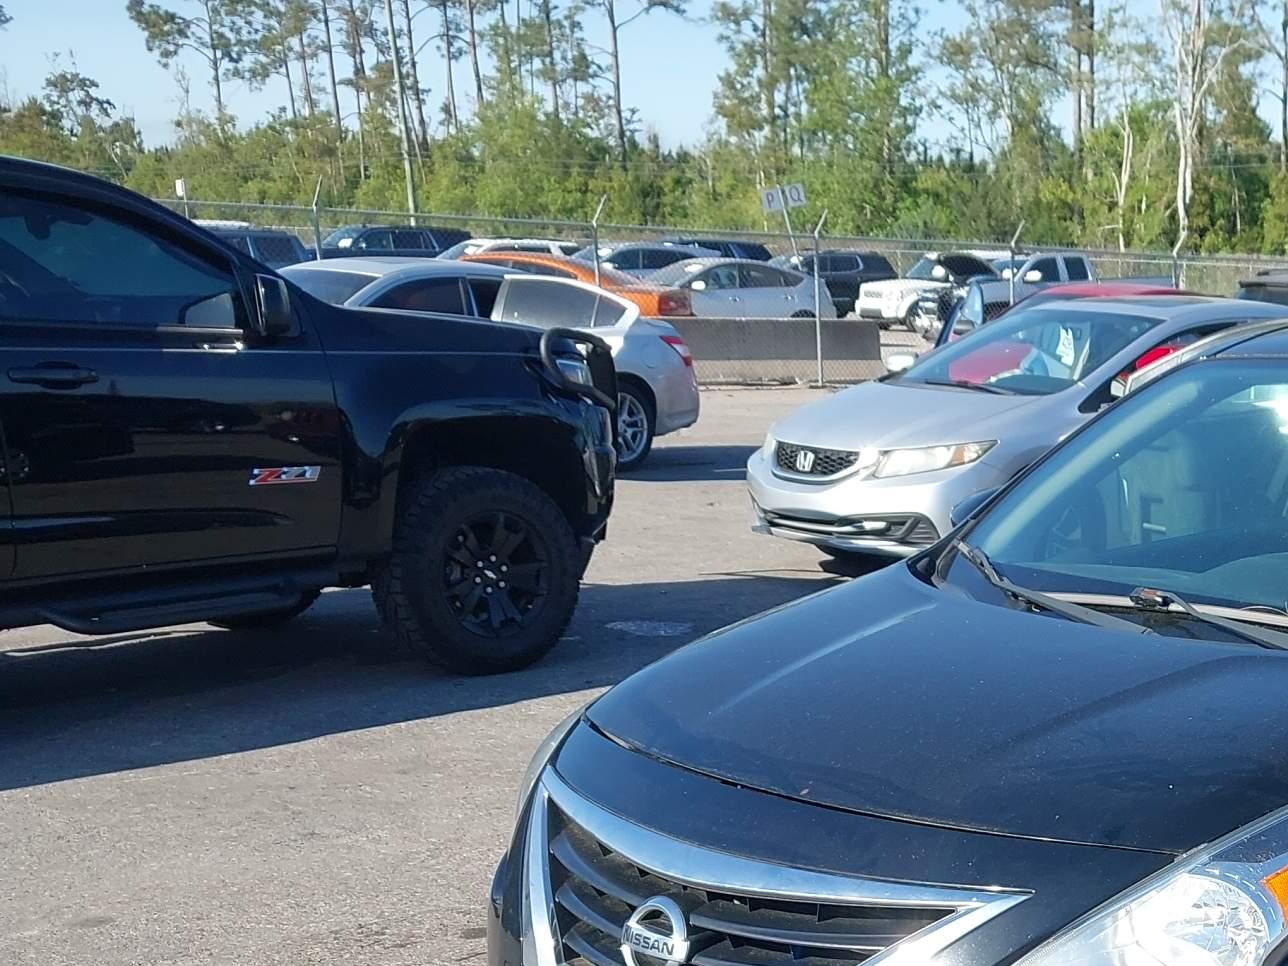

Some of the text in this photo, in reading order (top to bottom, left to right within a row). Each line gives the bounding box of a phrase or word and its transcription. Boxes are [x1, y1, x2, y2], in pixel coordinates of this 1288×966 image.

[766, 192, 775, 208] P
[789, 185, 804, 203] Q
[248, 466, 321, 486] Z71
[623, 924, 675, 956] NISSAN
